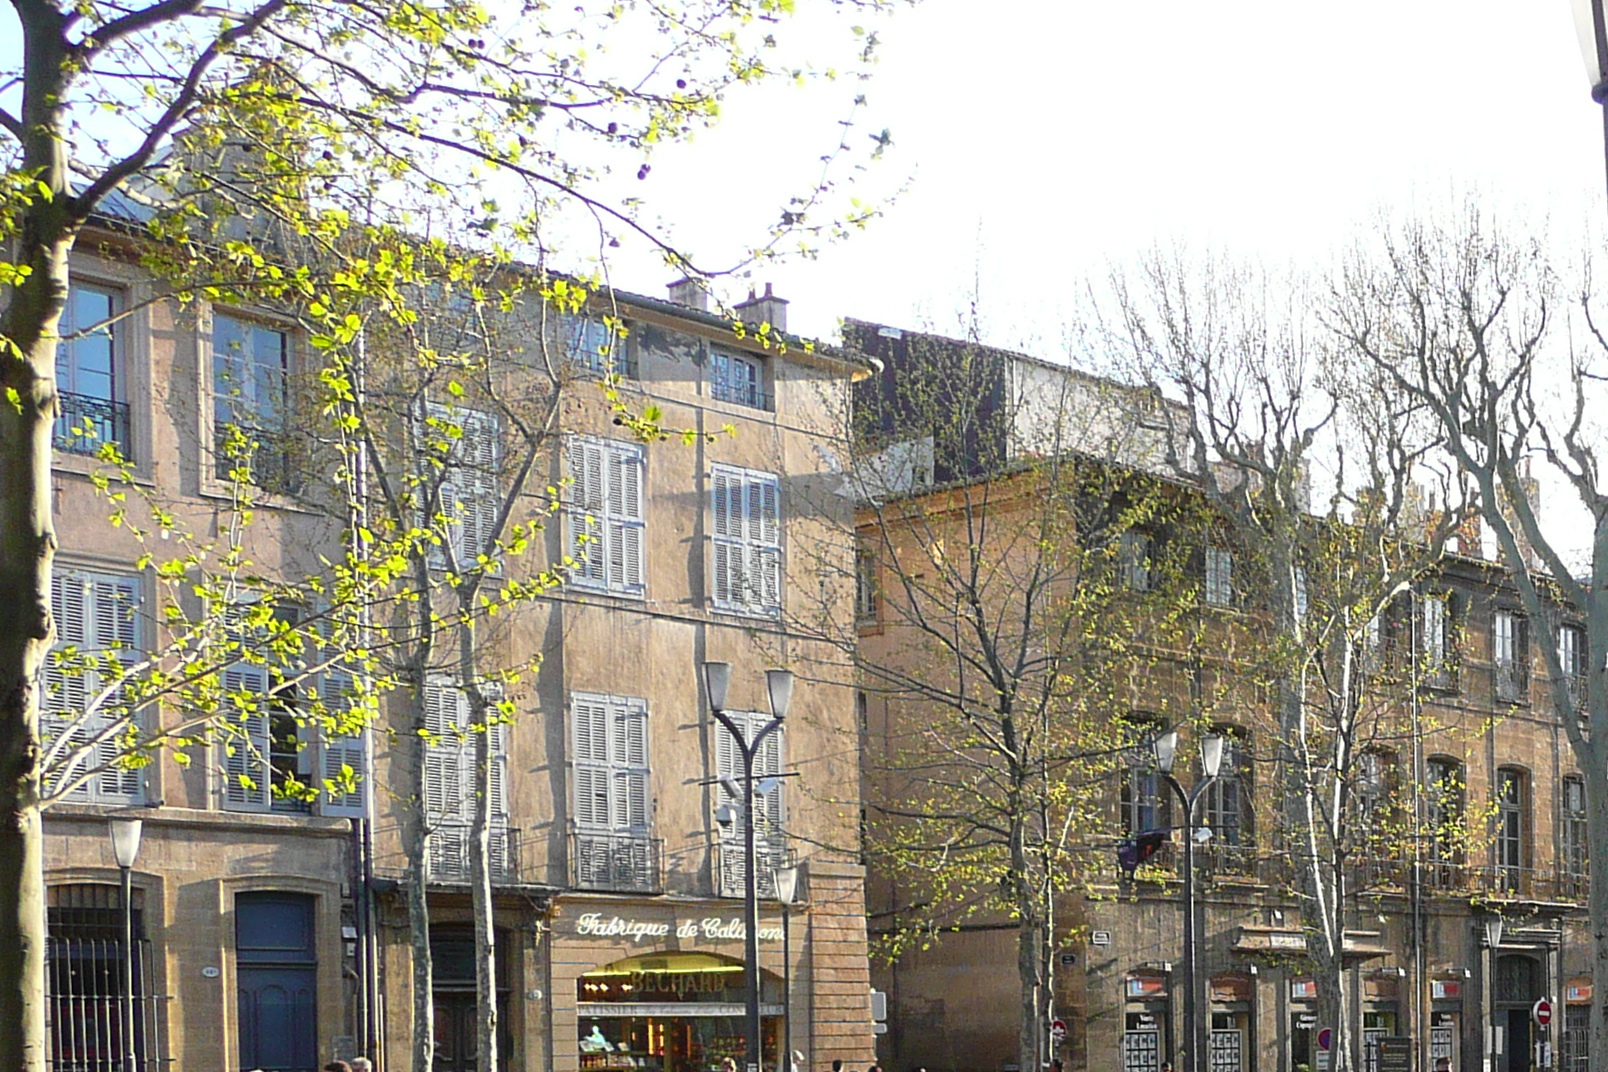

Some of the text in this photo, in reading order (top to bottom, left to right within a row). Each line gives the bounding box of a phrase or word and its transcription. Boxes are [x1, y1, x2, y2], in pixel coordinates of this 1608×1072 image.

[577, 913, 786, 942] Fabrique de Calion
[720, 1004, 784, 1016] CONEUR
